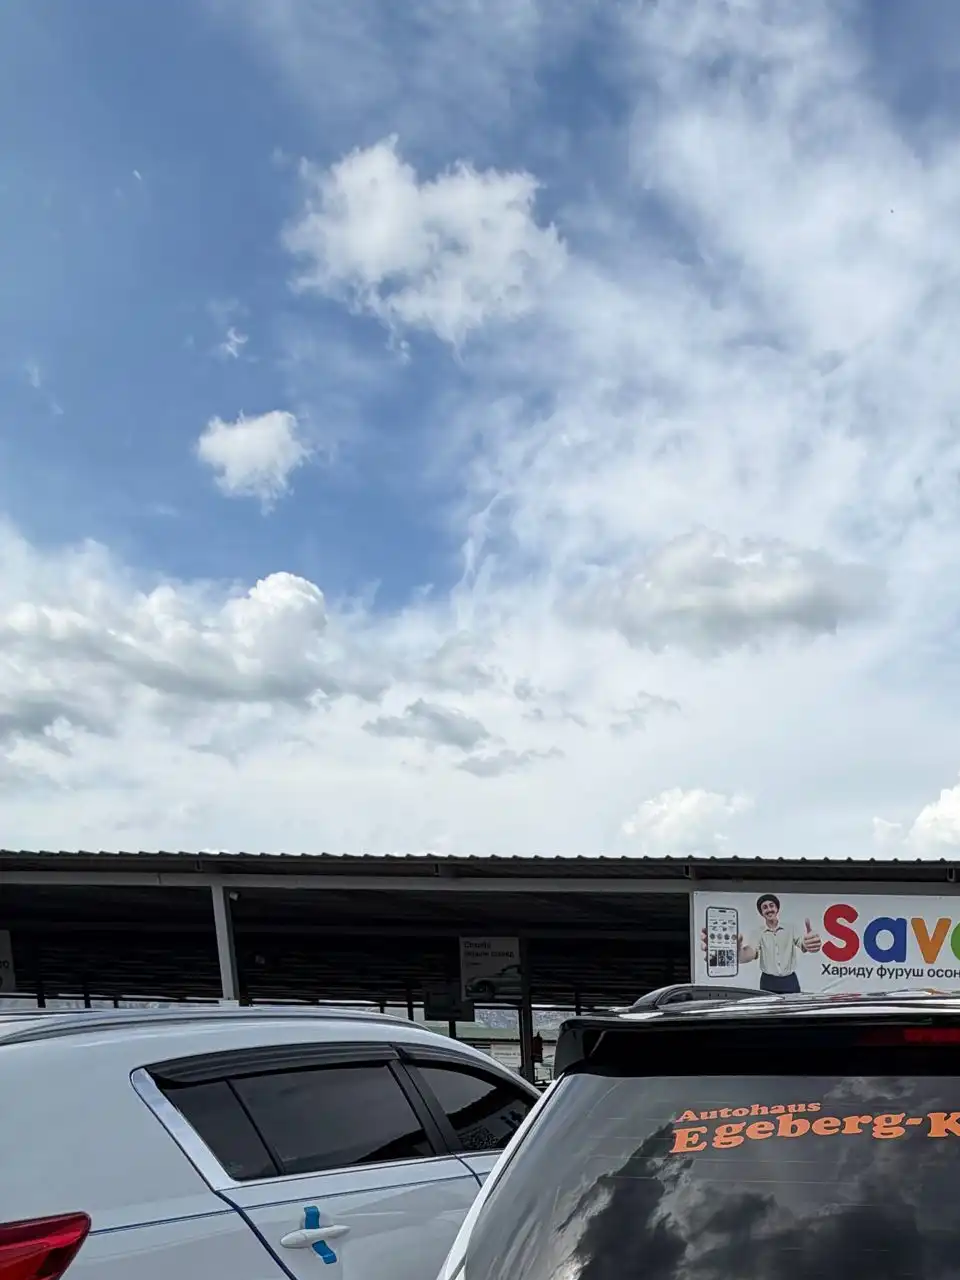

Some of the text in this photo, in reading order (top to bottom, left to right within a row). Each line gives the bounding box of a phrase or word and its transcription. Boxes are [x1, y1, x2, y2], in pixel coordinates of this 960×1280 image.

[821, 963, 874, 978] Хариду
[876, 964, 924, 979] фуруш
[675, 1102, 821, 1124] Autohaus
